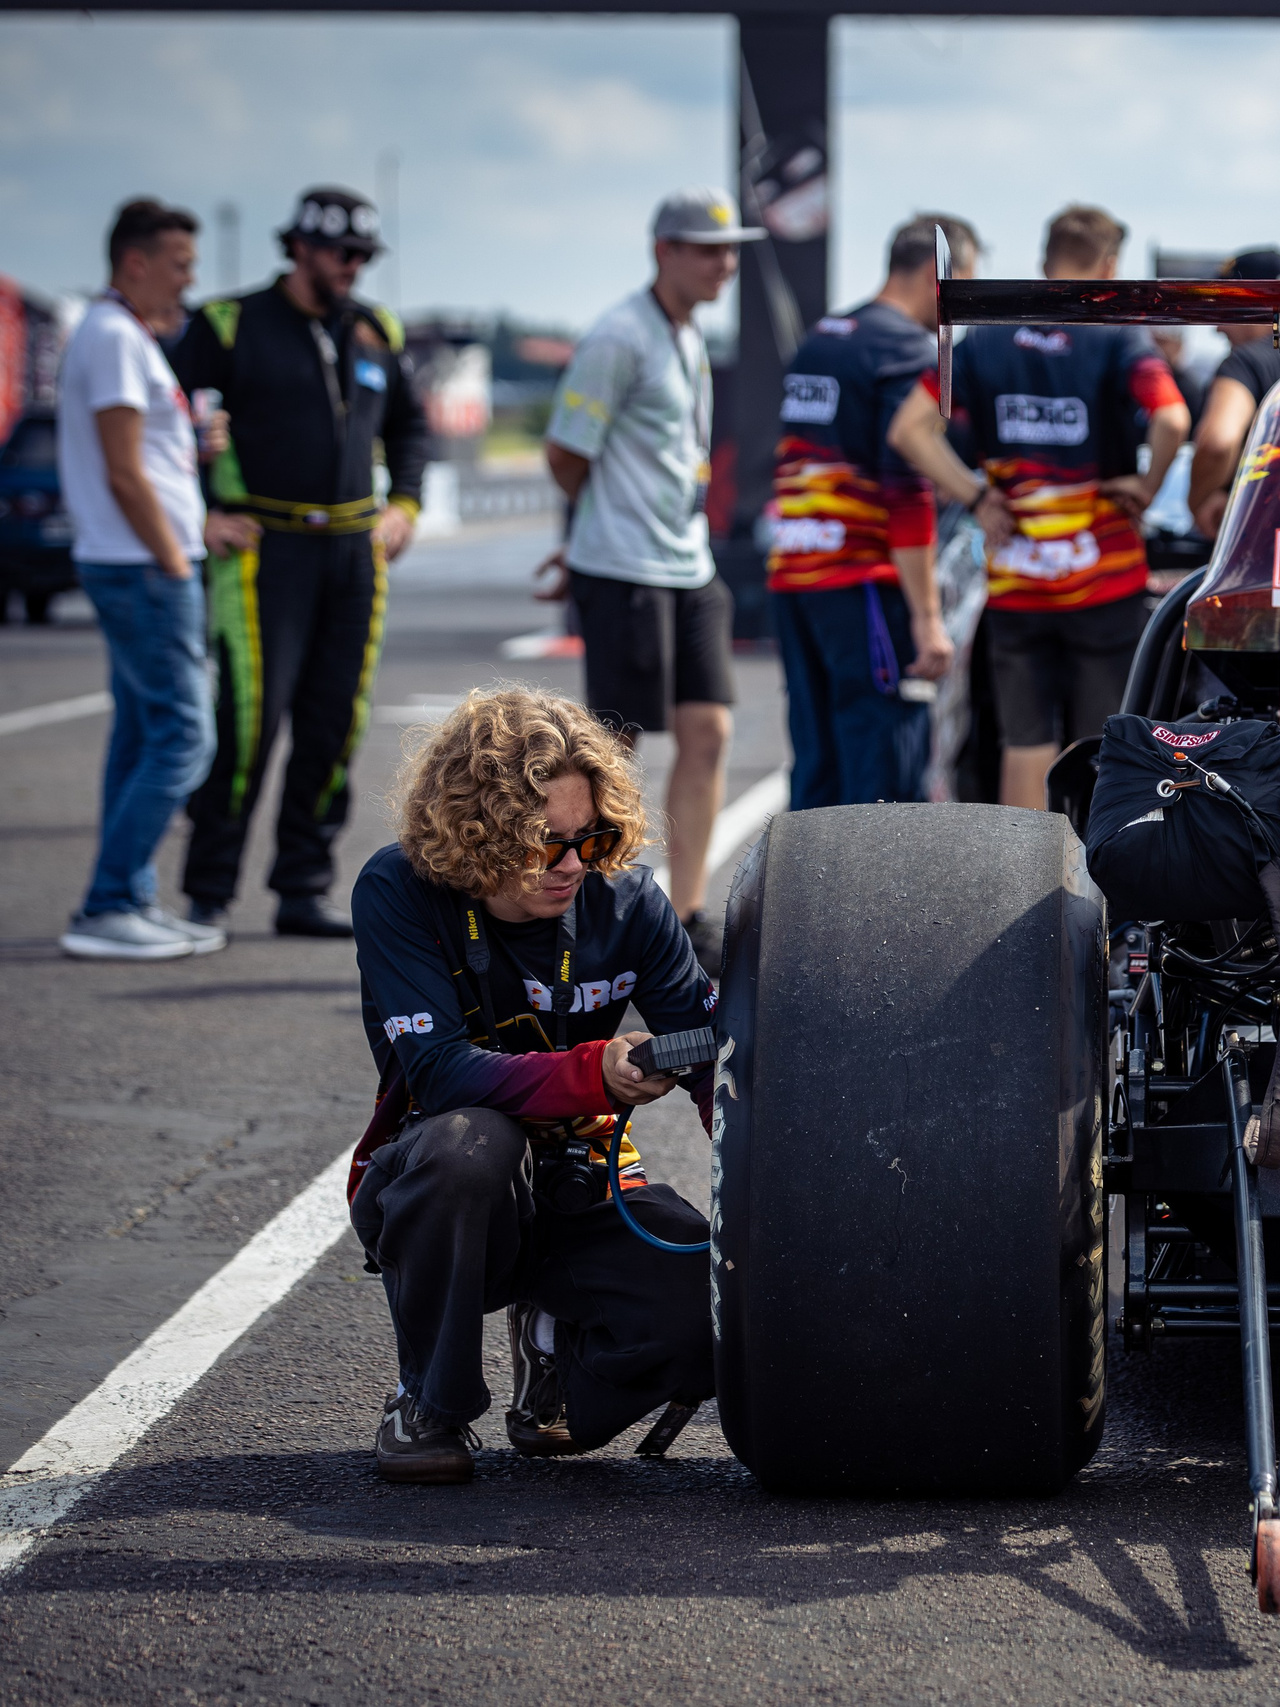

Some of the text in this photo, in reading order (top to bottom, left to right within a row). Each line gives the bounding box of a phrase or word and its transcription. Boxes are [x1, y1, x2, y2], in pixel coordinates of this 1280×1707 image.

[1155, 729, 1214, 746] SIMPSON
[467, 910, 479, 940] Nikon
[560, 950, 571, 983] Nikon
[566, 1147, 587, 1156] Nikon
